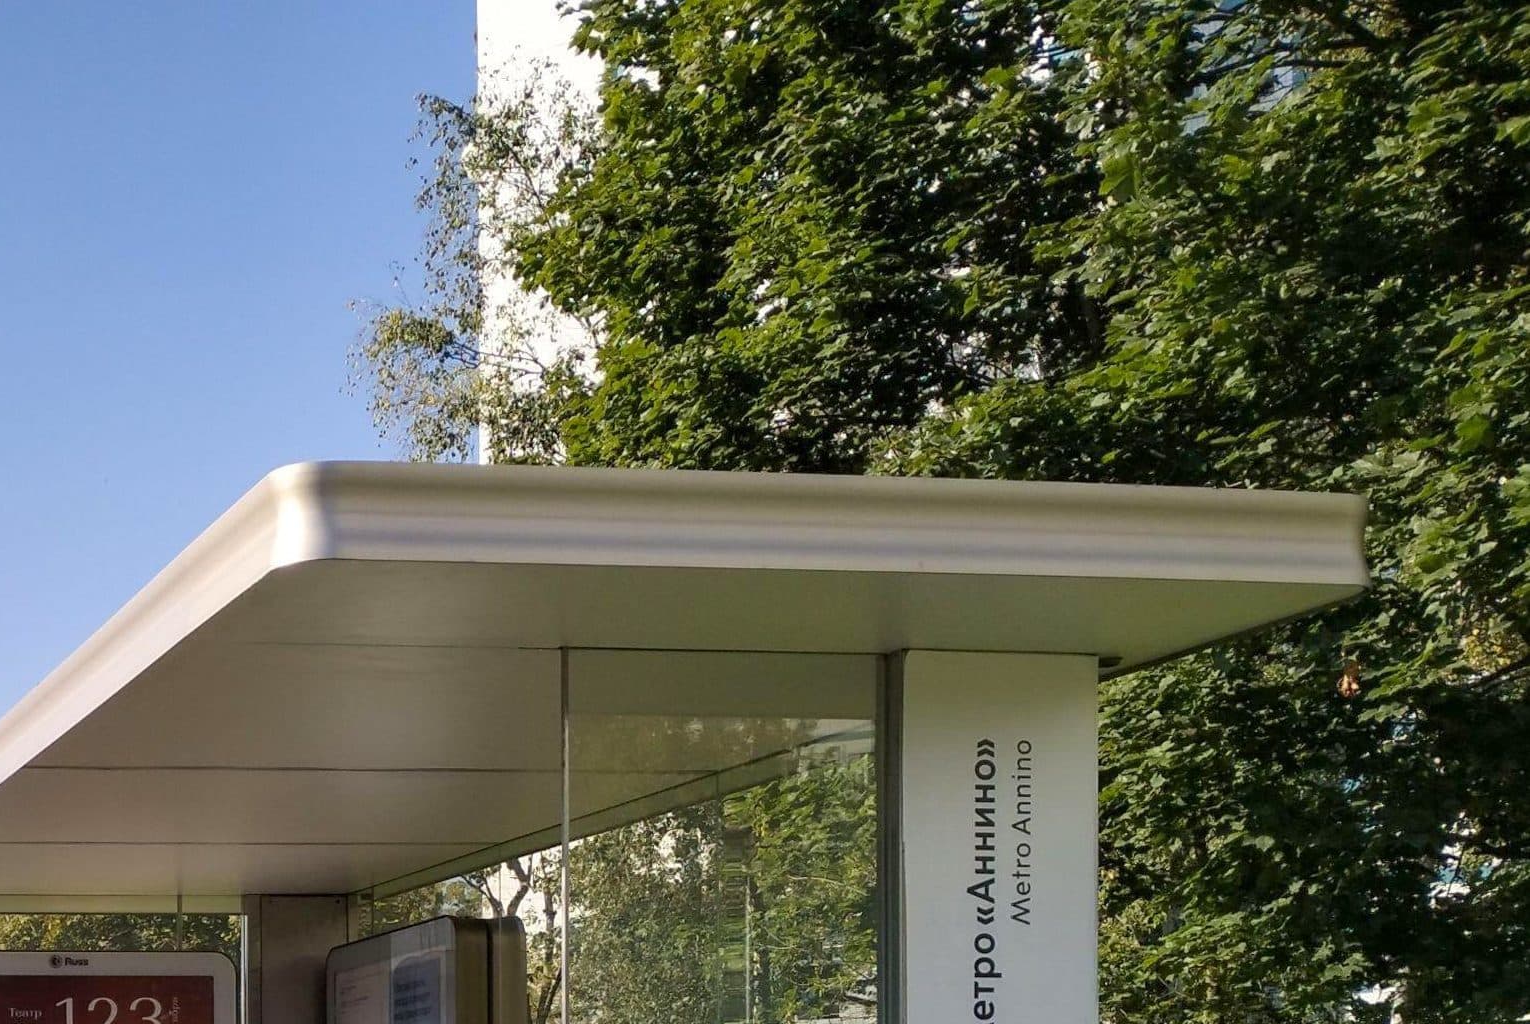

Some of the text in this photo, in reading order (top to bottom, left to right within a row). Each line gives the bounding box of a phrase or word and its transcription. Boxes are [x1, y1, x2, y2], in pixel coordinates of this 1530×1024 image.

[966, 738, 996, 925] «Аннино»
[1010, 739, 1032, 925] Metro Annino
[8, 1008, 42, 1020] Театр
